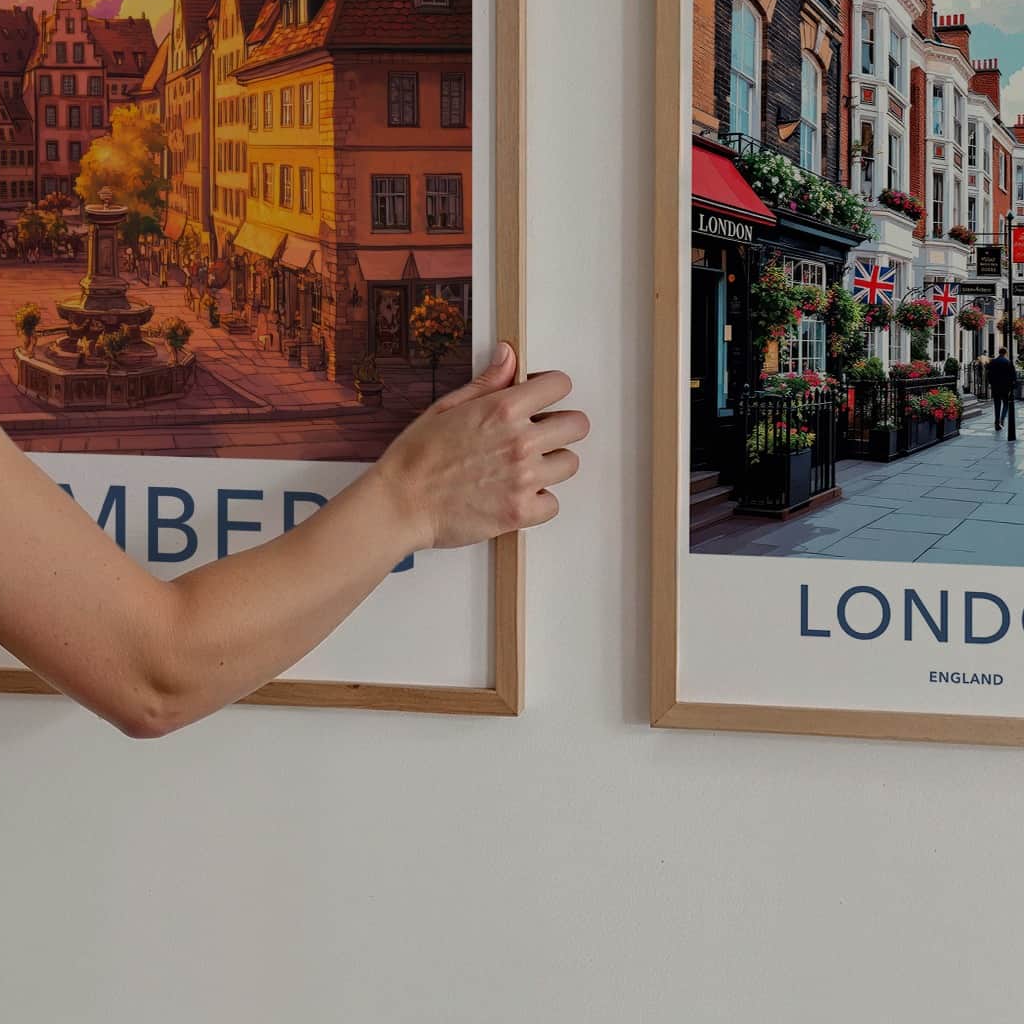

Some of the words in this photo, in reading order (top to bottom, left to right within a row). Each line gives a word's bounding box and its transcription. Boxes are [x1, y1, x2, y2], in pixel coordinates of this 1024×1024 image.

[699, 213, 753, 242] LONDON
[800, 584, 1024, 645] LOND
[929, 671, 1004, 686] ENGLAND
